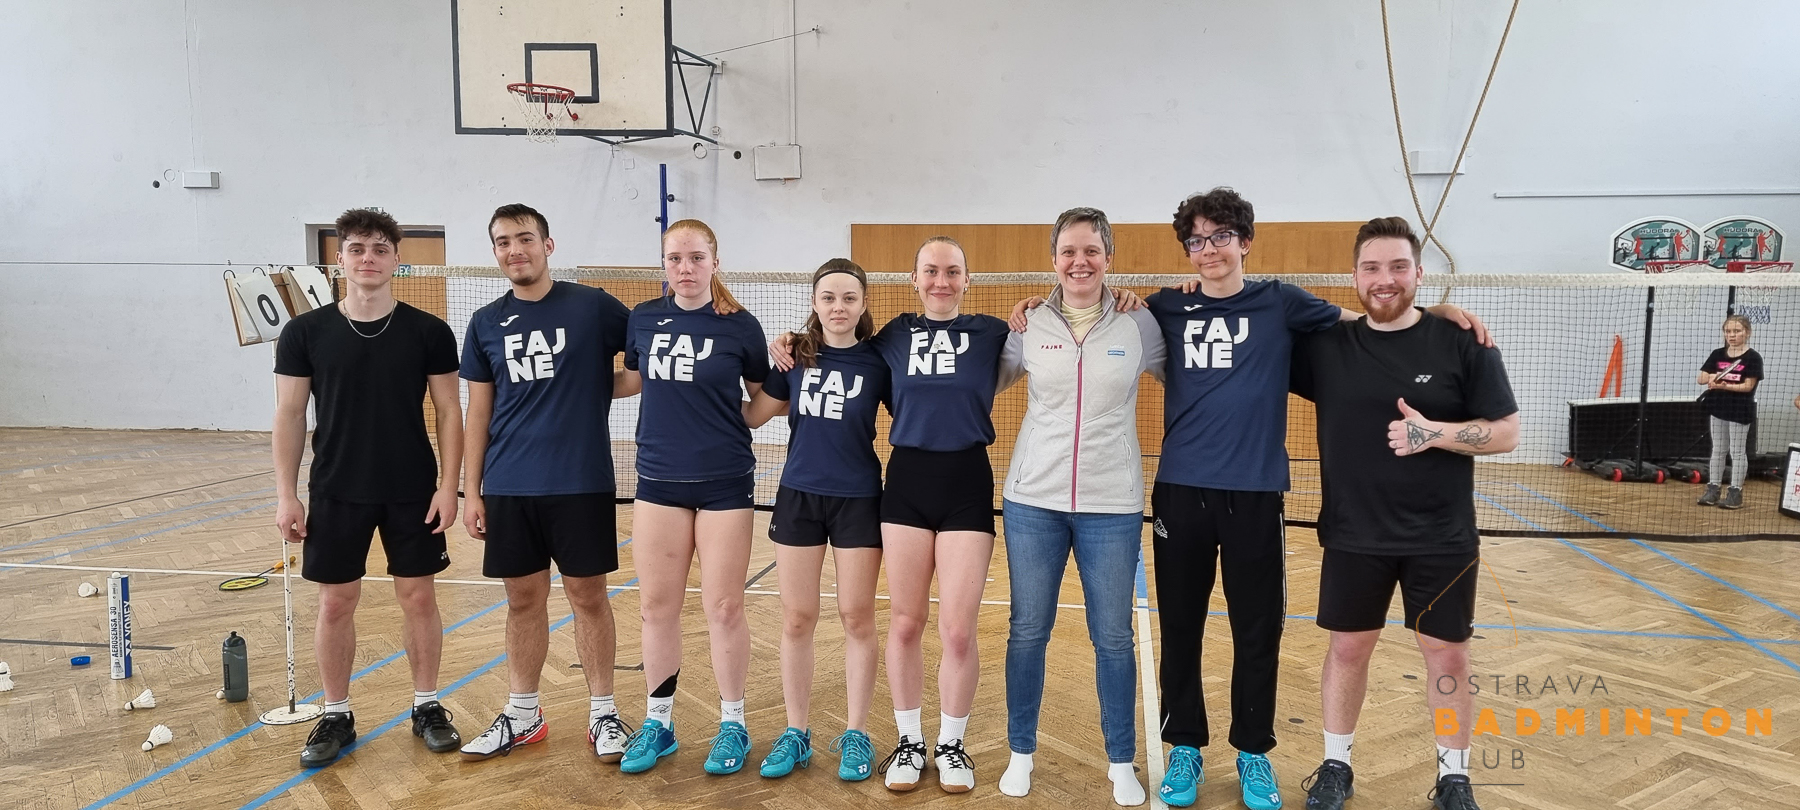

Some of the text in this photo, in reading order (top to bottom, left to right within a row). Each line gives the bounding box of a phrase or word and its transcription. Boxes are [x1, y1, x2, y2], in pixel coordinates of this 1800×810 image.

[257, 293, 280, 327] 0
[307, 285, 322, 307] 1
[504, 328, 566, 359] FAJ
[910, 330, 970, 355] FAJ
[1184, 317, 1249, 344] FAJ
[649, 333, 714, 361] FAJ
[1184, 342, 1233, 368] NE
[506, 354, 554, 383] NE
[648, 355, 695, 382] NE
[907, 353, 956, 376] NE
[801, 368, 864, 399] FAJ
[799, 391, 845, 420] NE
[110, 606, 119, 658] AEROSENSA 30
